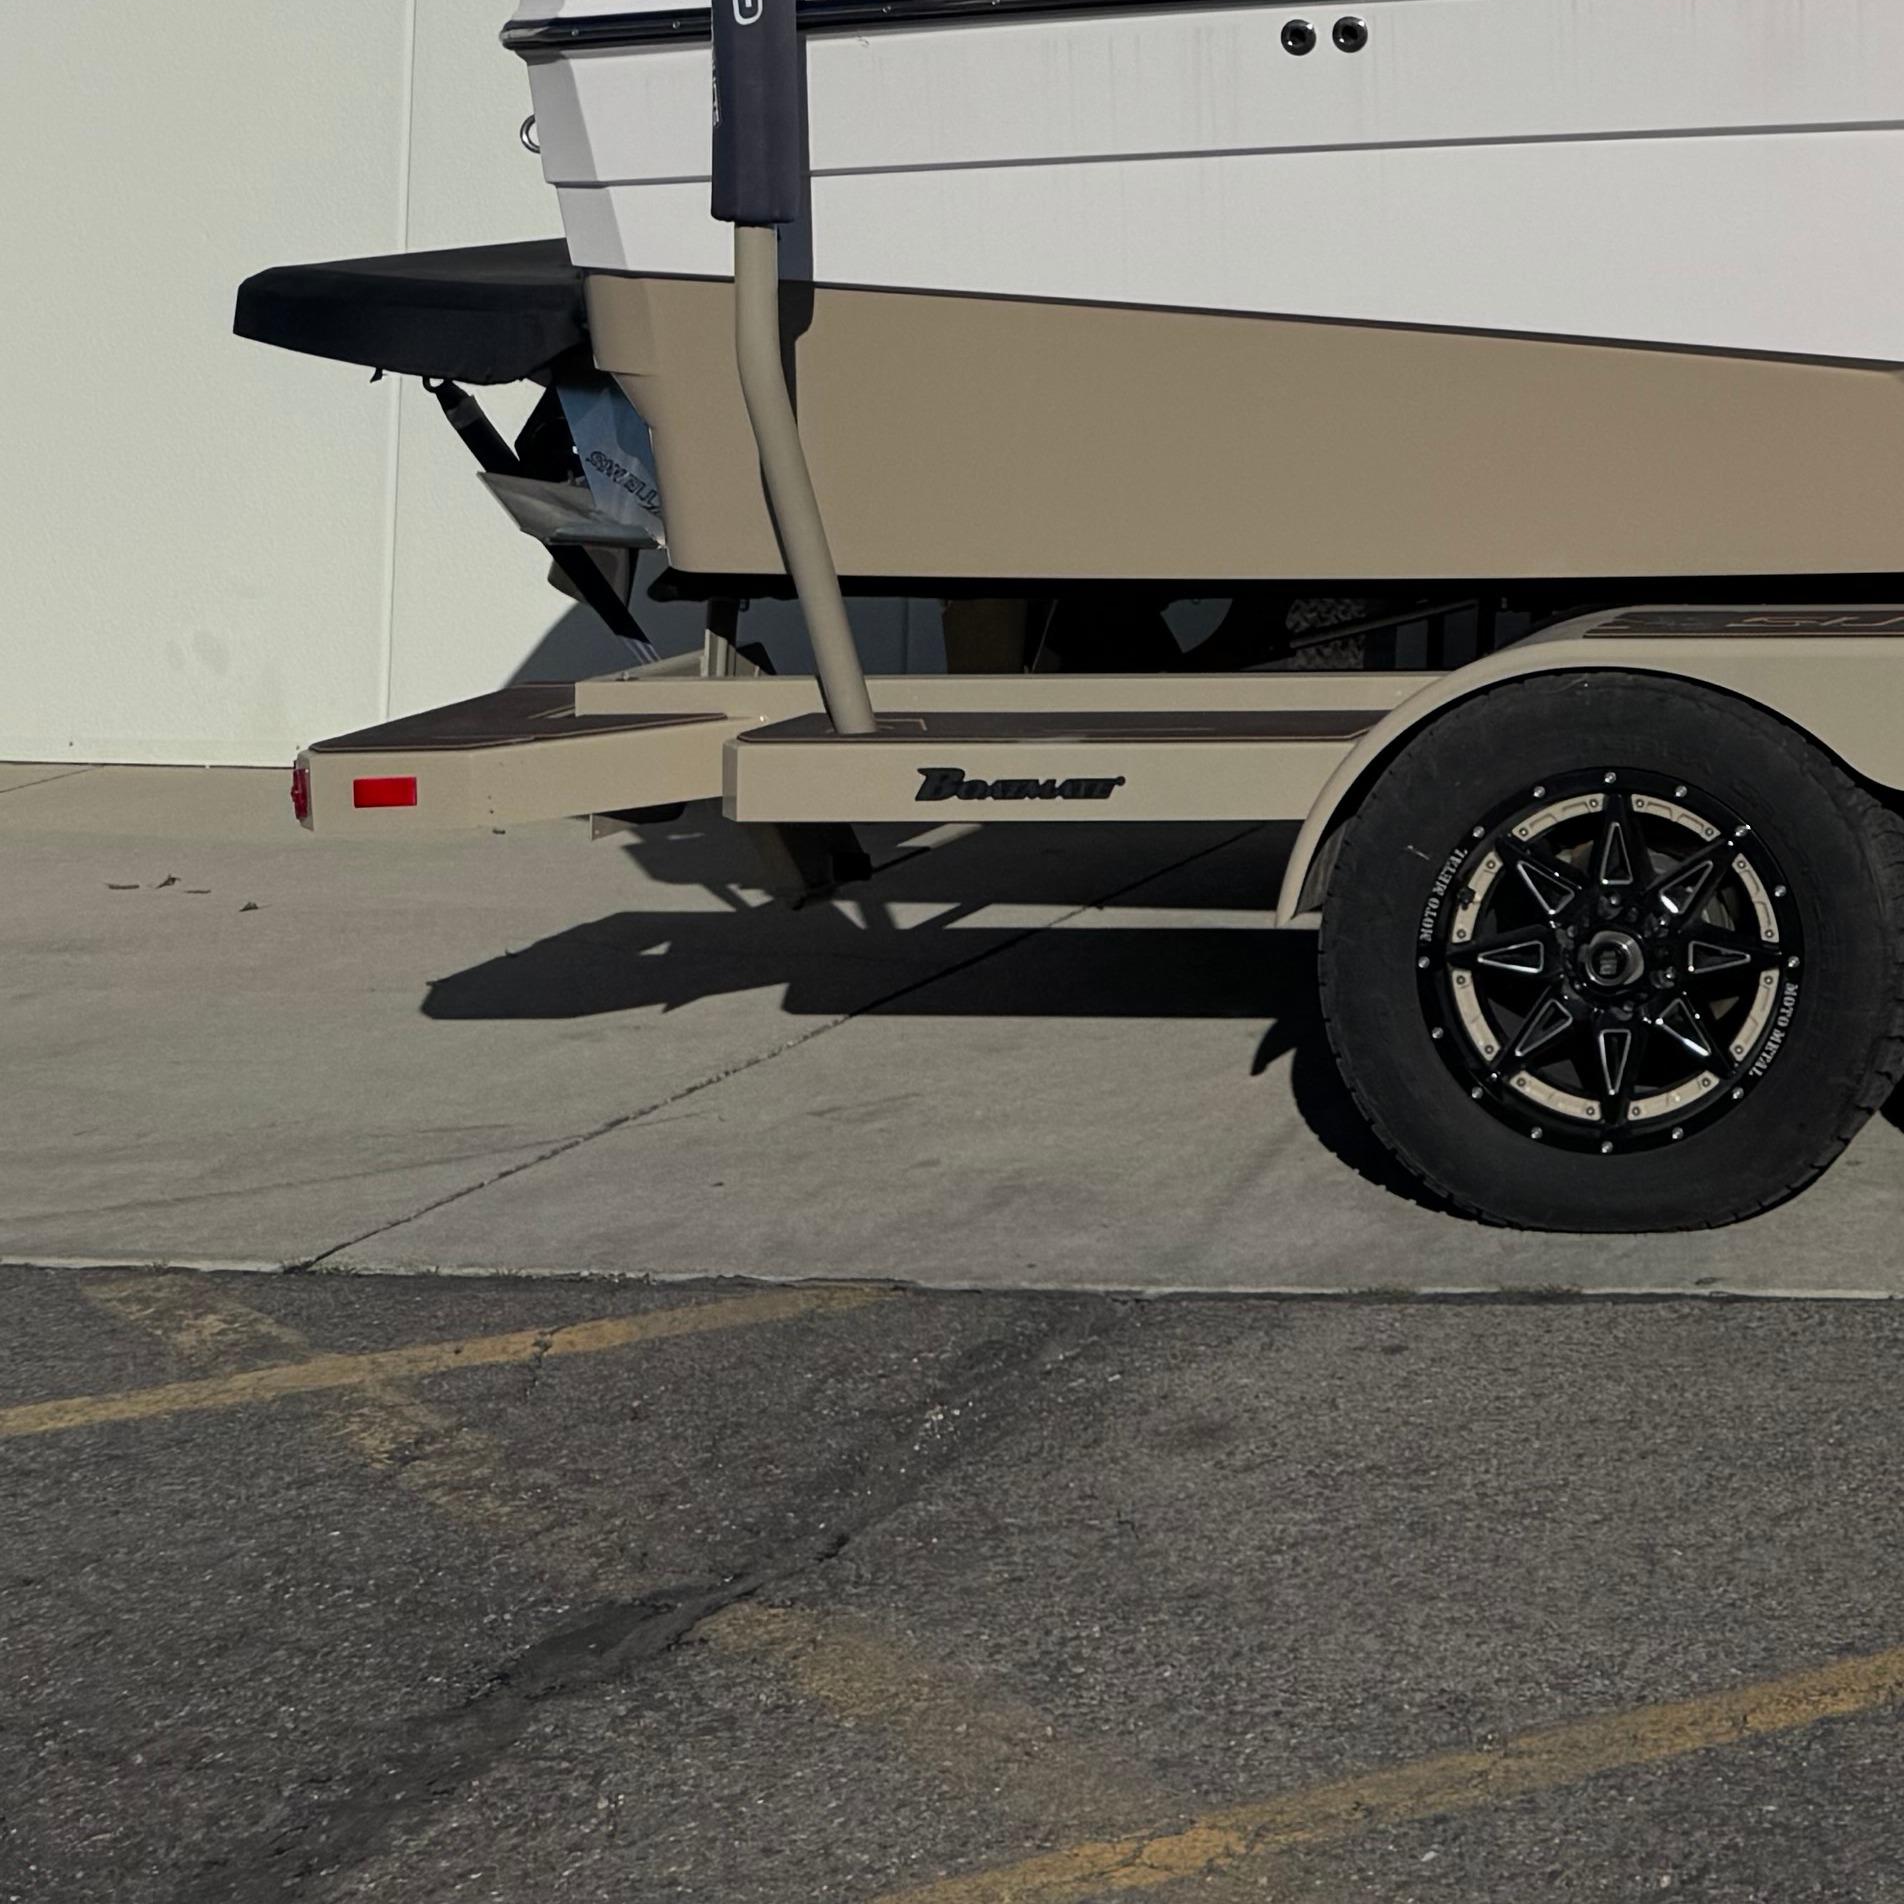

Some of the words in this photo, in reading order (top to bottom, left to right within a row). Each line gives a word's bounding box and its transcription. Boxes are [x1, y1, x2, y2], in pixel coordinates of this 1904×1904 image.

[1420, 897, 1441, 942] MOTO
[1432, 848, 1469, 897] METAL
[1777, 982, 1799, 1028] MOTO
[1748, 1028, 1786, 1077] METAL
